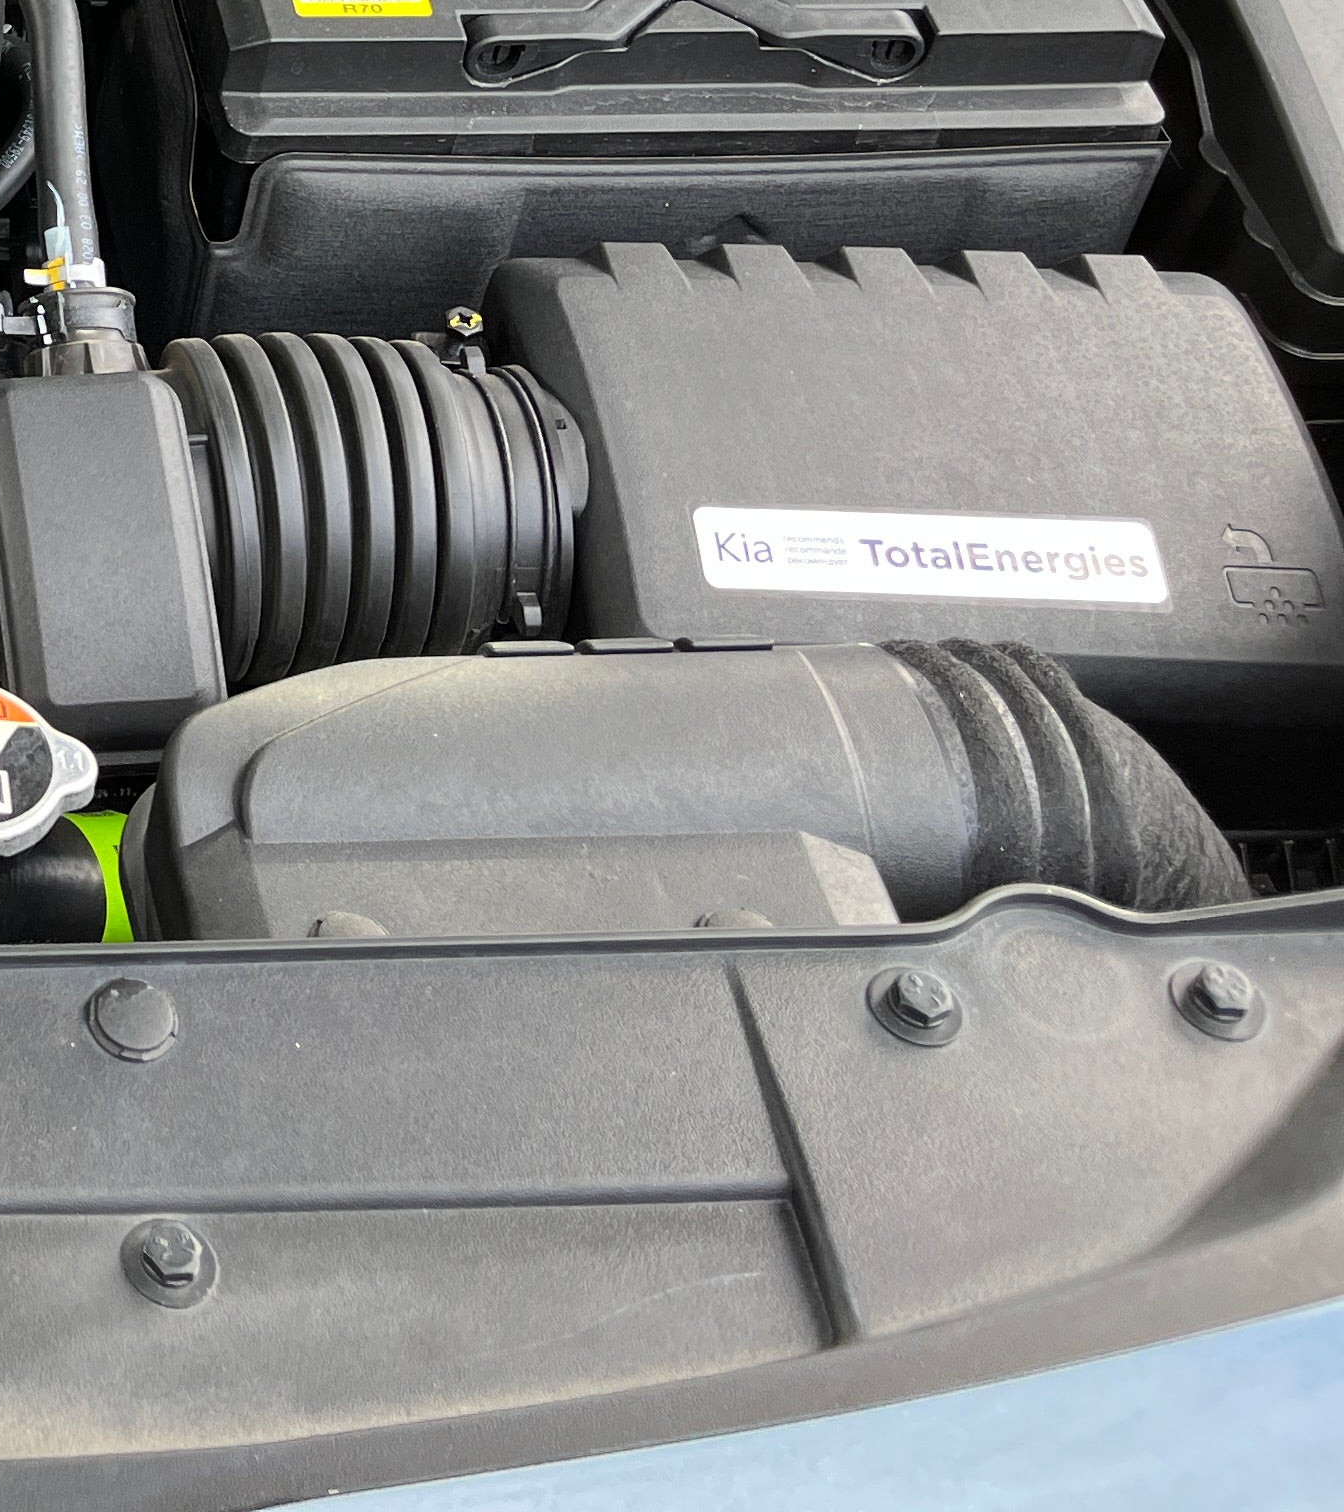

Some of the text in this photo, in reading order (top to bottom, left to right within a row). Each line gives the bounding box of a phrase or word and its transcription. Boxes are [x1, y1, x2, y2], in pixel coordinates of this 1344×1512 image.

[342, 3, 383, 14] R70
[713, 531, 774, 566] Kia
[859, 538, 1150, 581] TotalEnergies
[57, 749, 84, 772] 1.1
